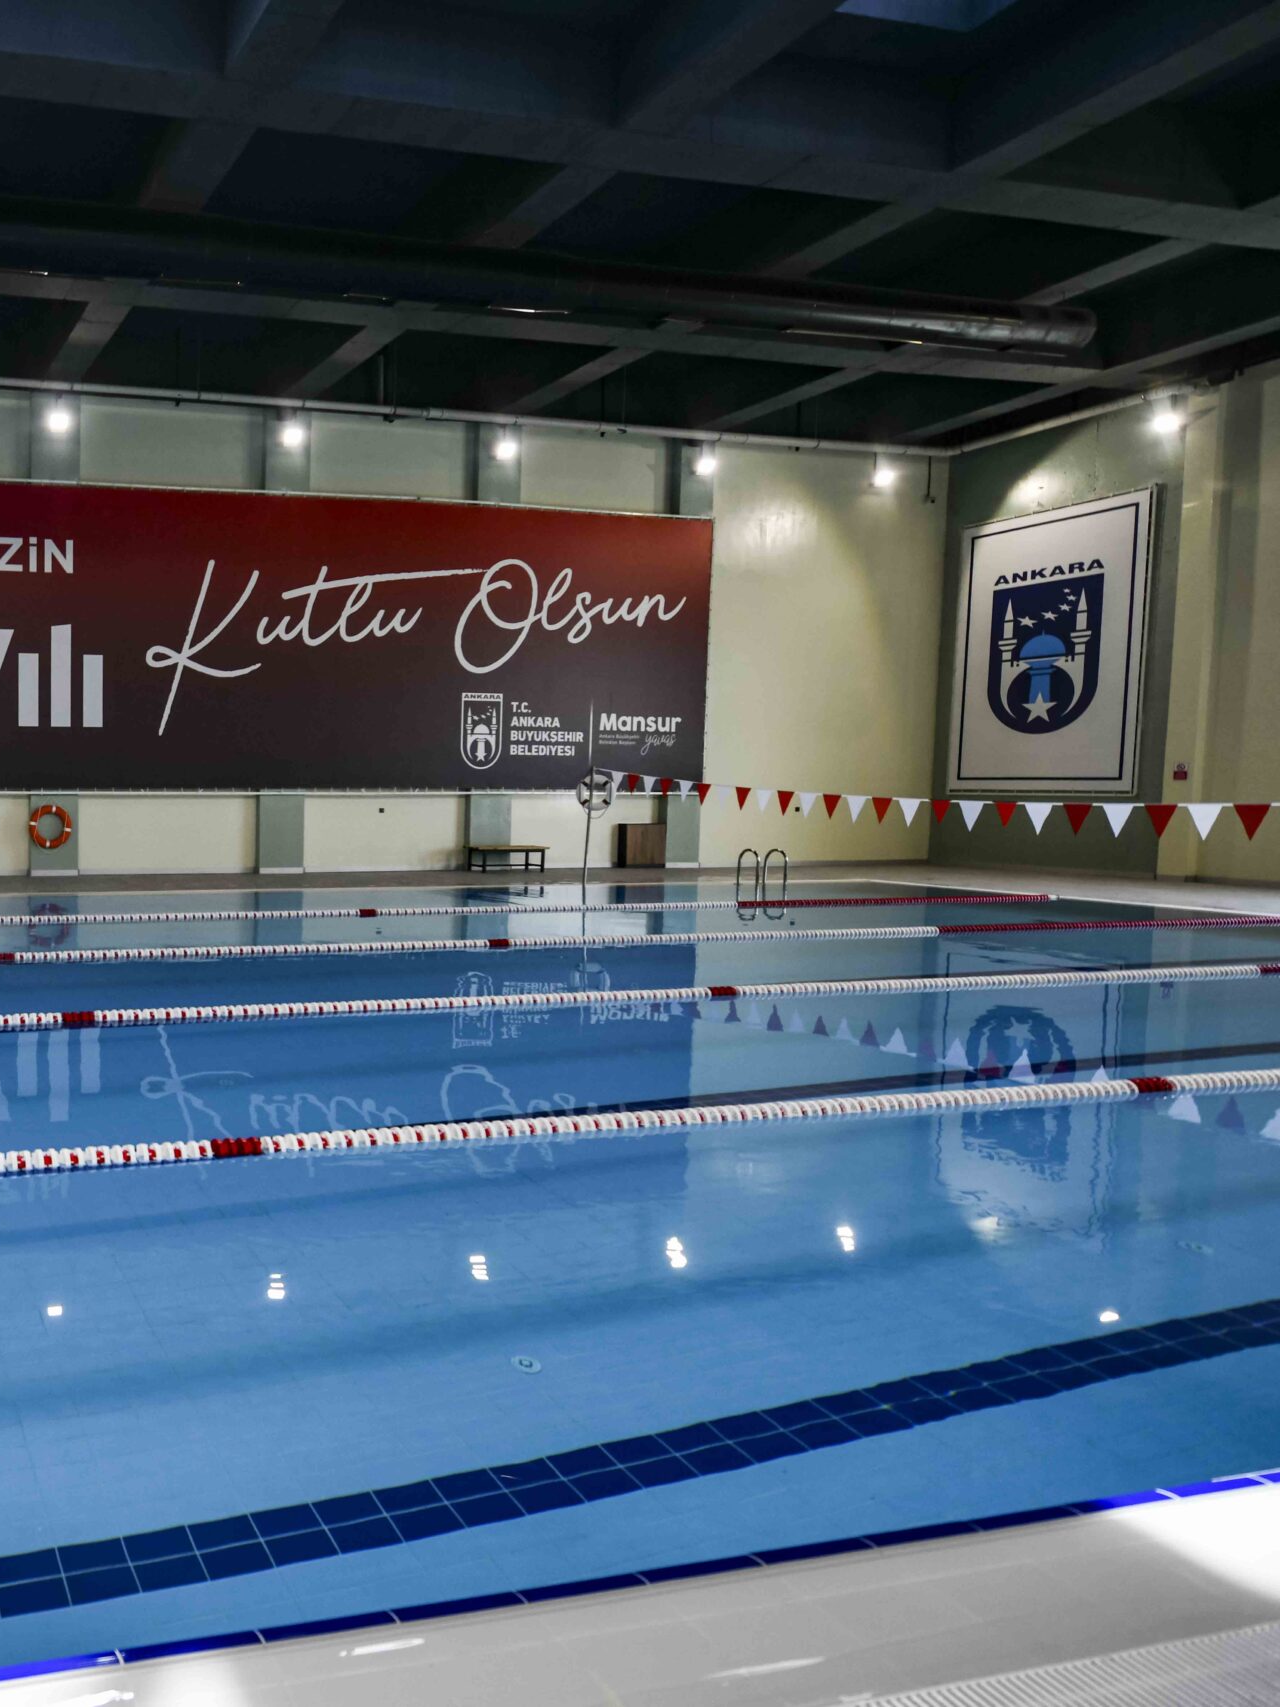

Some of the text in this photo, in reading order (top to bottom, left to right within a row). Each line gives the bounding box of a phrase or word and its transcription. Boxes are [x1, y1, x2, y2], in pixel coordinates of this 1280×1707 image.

[994, 558, 1104, 586] ANKARA
[147, 558, 687, 736] Kutlu Olsun
[510, 701, 532, 713] T.C.
[510, 716, 560, 728] ANKARA
[599, 712, 682, 733] Mansur
